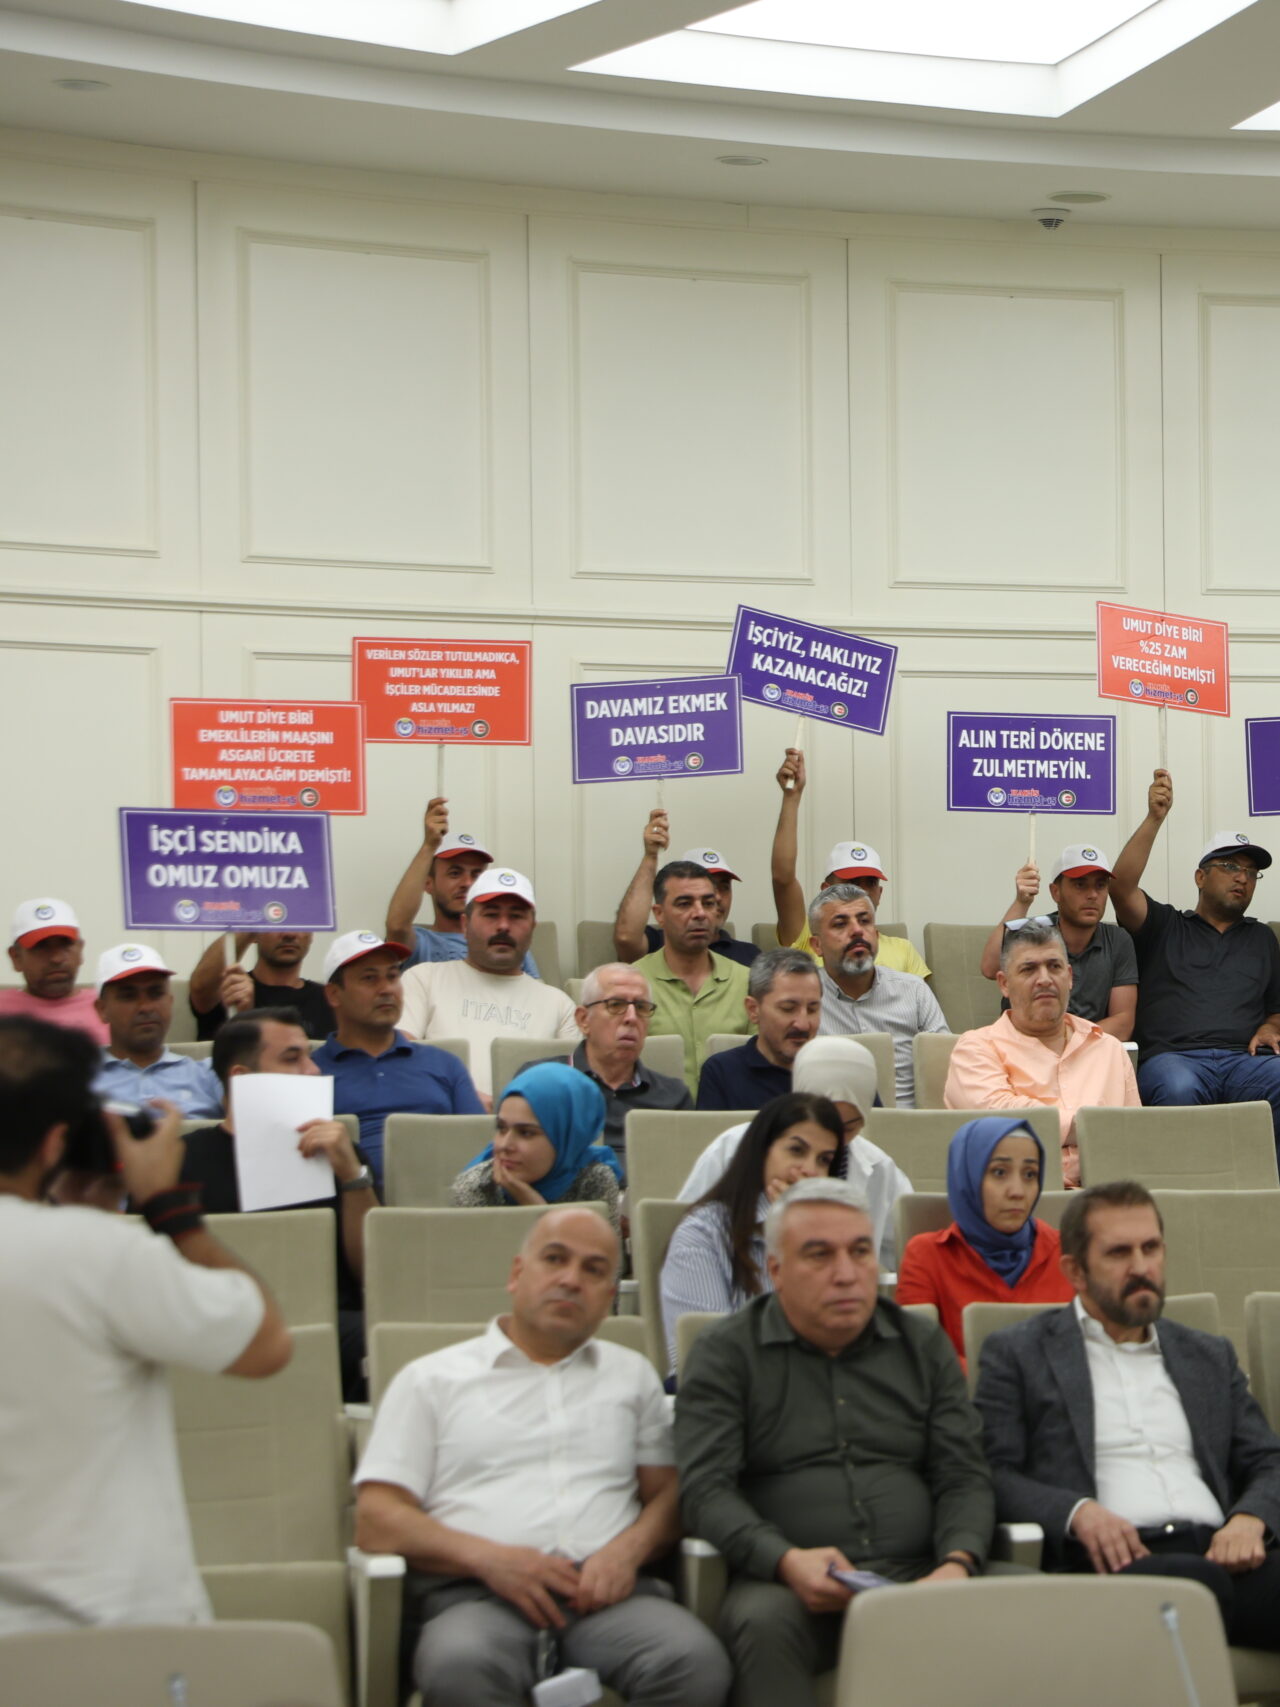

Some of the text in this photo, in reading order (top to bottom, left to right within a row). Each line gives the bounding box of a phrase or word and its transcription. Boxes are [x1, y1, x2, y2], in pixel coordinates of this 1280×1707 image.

[1122, 617, 1203, 643] UMUT DİYE BİRİ
[366, 647, 405, 660] VERİLEN
[407, 648, 443, 661] SÖZLER
[747, 621, 882, 675] İŞÇİYİZ, HAKLIYIZ
[1139, 640, 1187, 660] %25 ZAM
[439, 668, 473, 679] YIKILIR
[474, 669, 496, 679] AMA
[752, 653, 869, 698] KAZANACAĞIZ!
[1111, 655, 1216, 684] VERECEĞİM DEMİŞTİ
[385, 682, 501, 697] İŞÇİLER MÜCADELESİNDE
[218, 709, 313, 725] UMUT DİYE BİRİ
[410, 702, 475, 713] ASLA YILMAZ!
[586, 692, 728, 719] DAVAMIZ EKMEK
[198, 728, 334, 745] EMEKLİLERİN MAAŞINI
[611, 723, 705, 747] DAVASIDIR
[958, 728, 1105, 751] ALIN TERİ DÖKENE
[218, 747, 316, 763] ASGARİ ÜCRETE
[182, 766, 296, 781] TAMAMLAYACAĞIM
[972, 757, 1092, 780] ZULMETMEYİN.
[150, 824, 304, 856] İŞÇİ SENDİKA
[147, 864, 309, 889] OMUZ OMUZA
[462, 998, 532, 1031] ITALY
